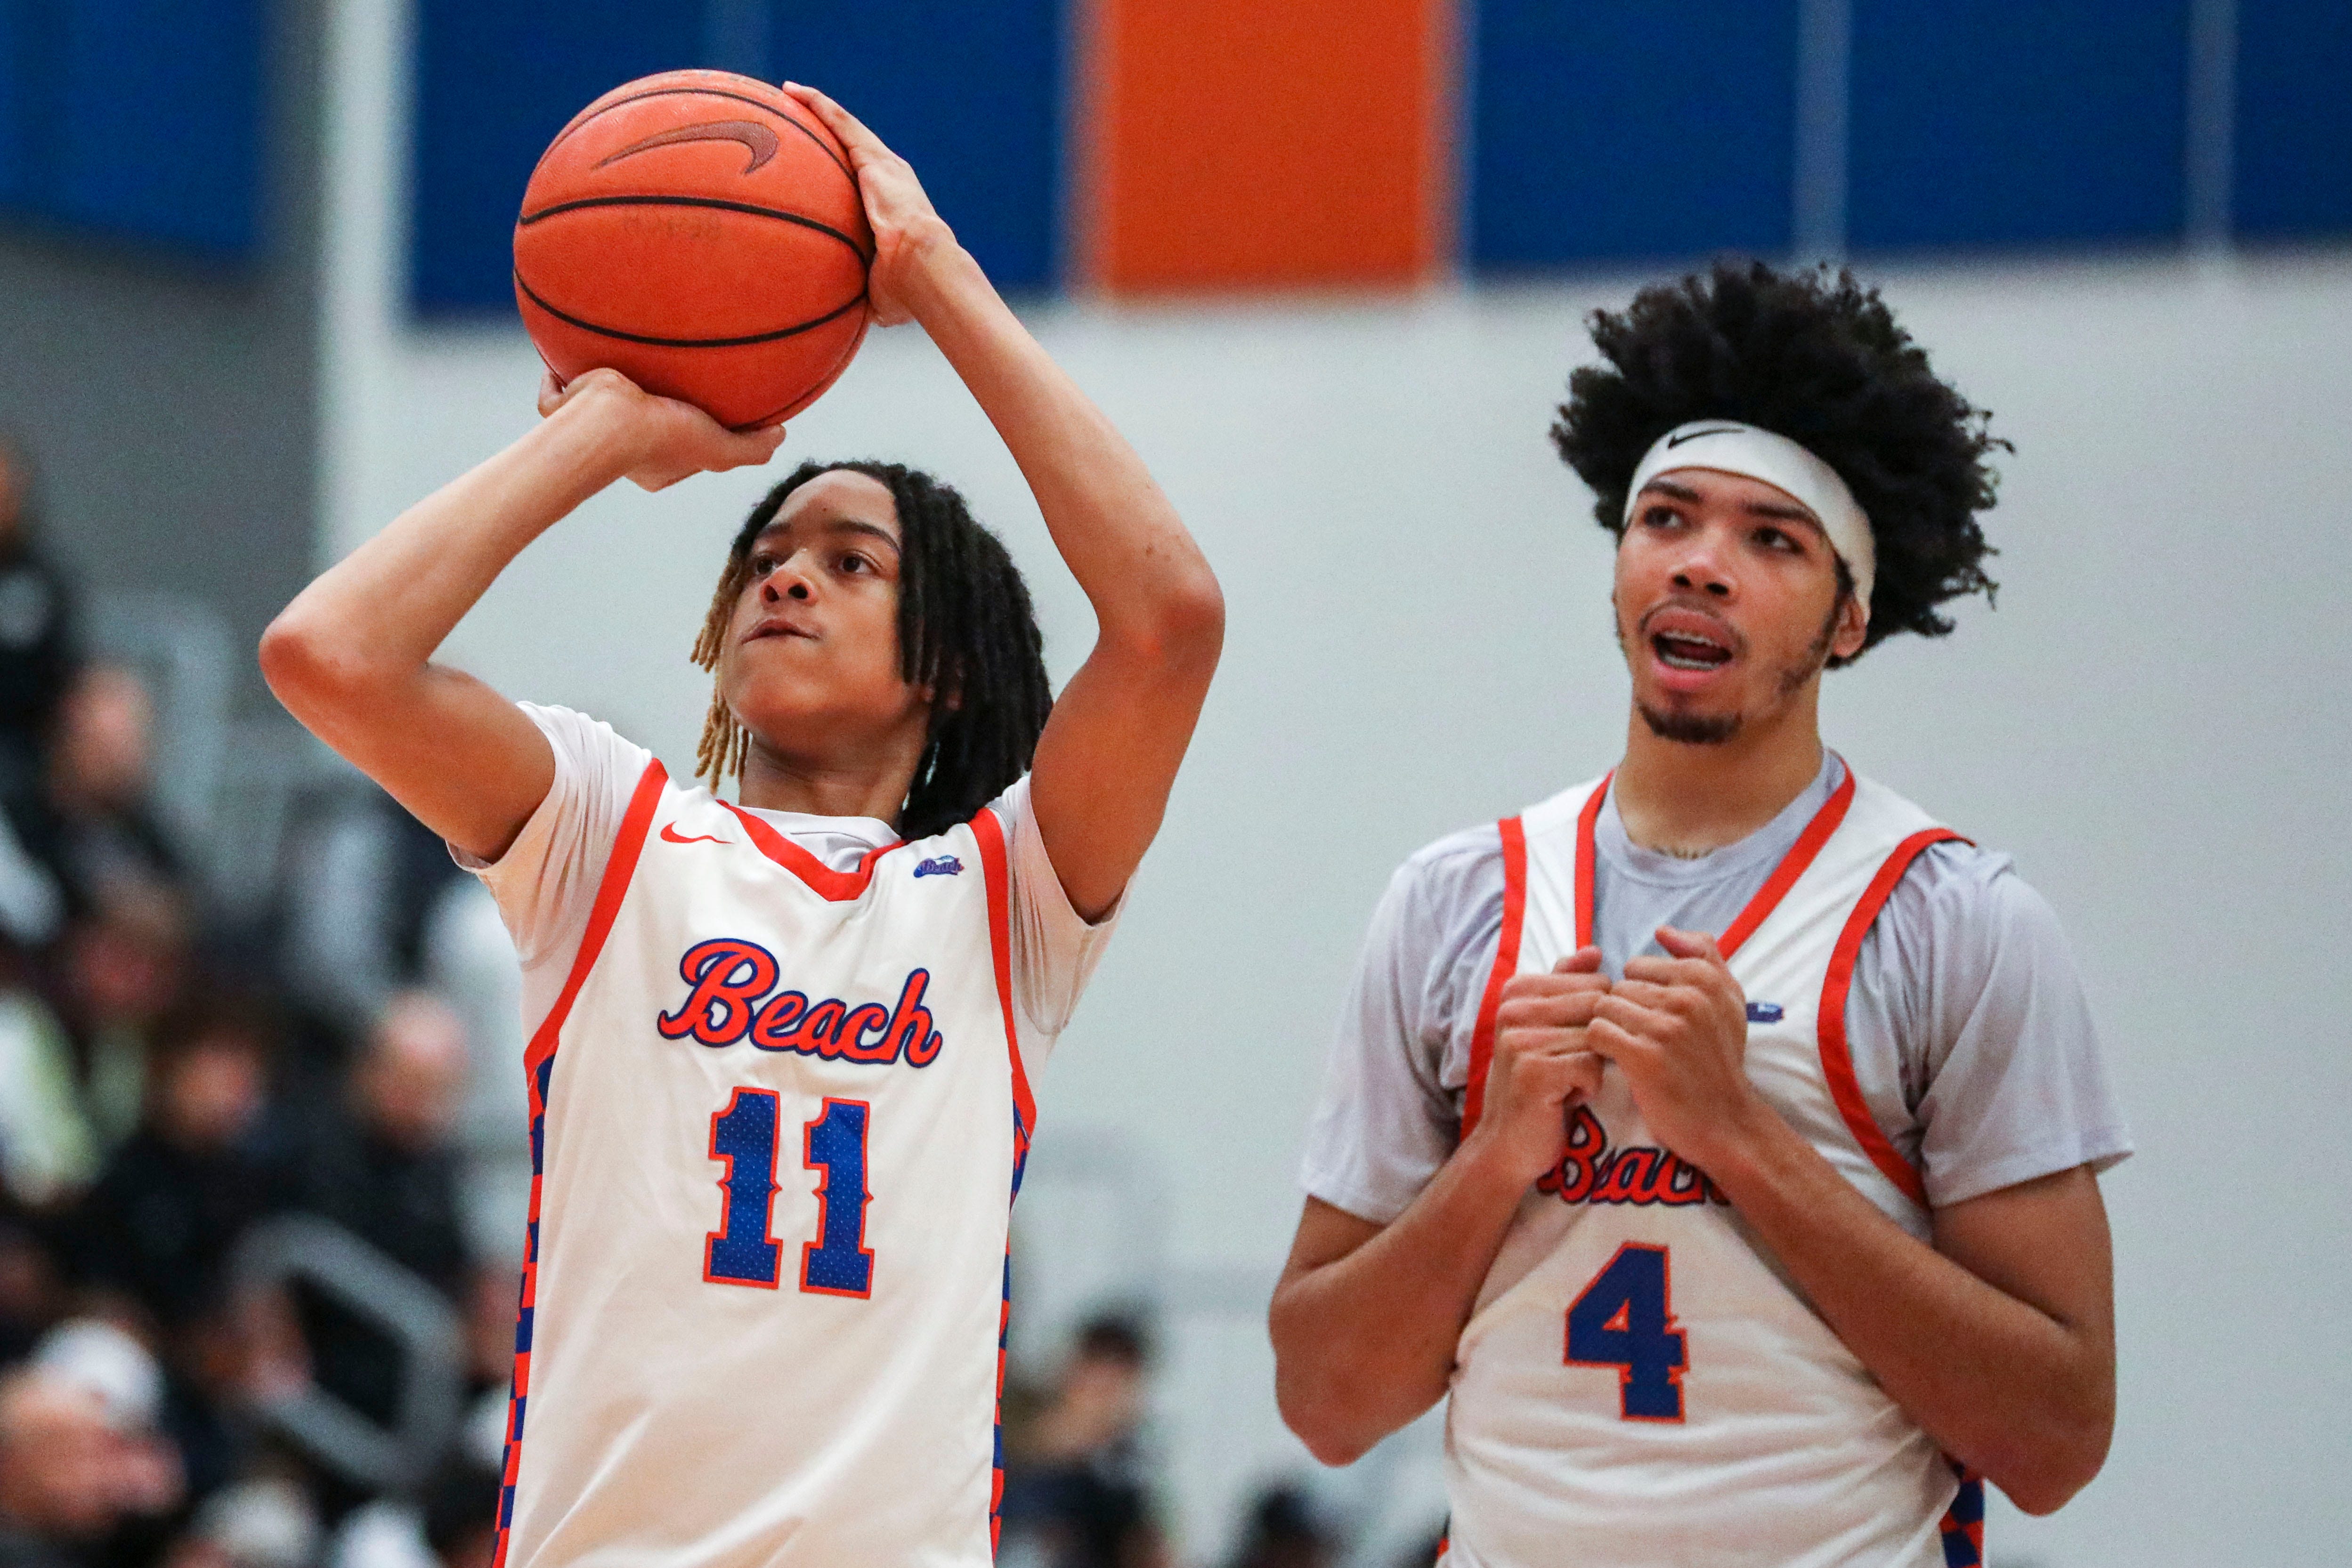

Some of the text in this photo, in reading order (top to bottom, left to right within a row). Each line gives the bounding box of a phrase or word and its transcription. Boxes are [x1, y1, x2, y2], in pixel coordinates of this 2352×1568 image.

[658, 938, 943, 1068] Beach
[703, 1086, 875, 1300] 11
[1536, 1104, 1732, 1207] Bac
[1563, 1240, 1690, 1425] 4
